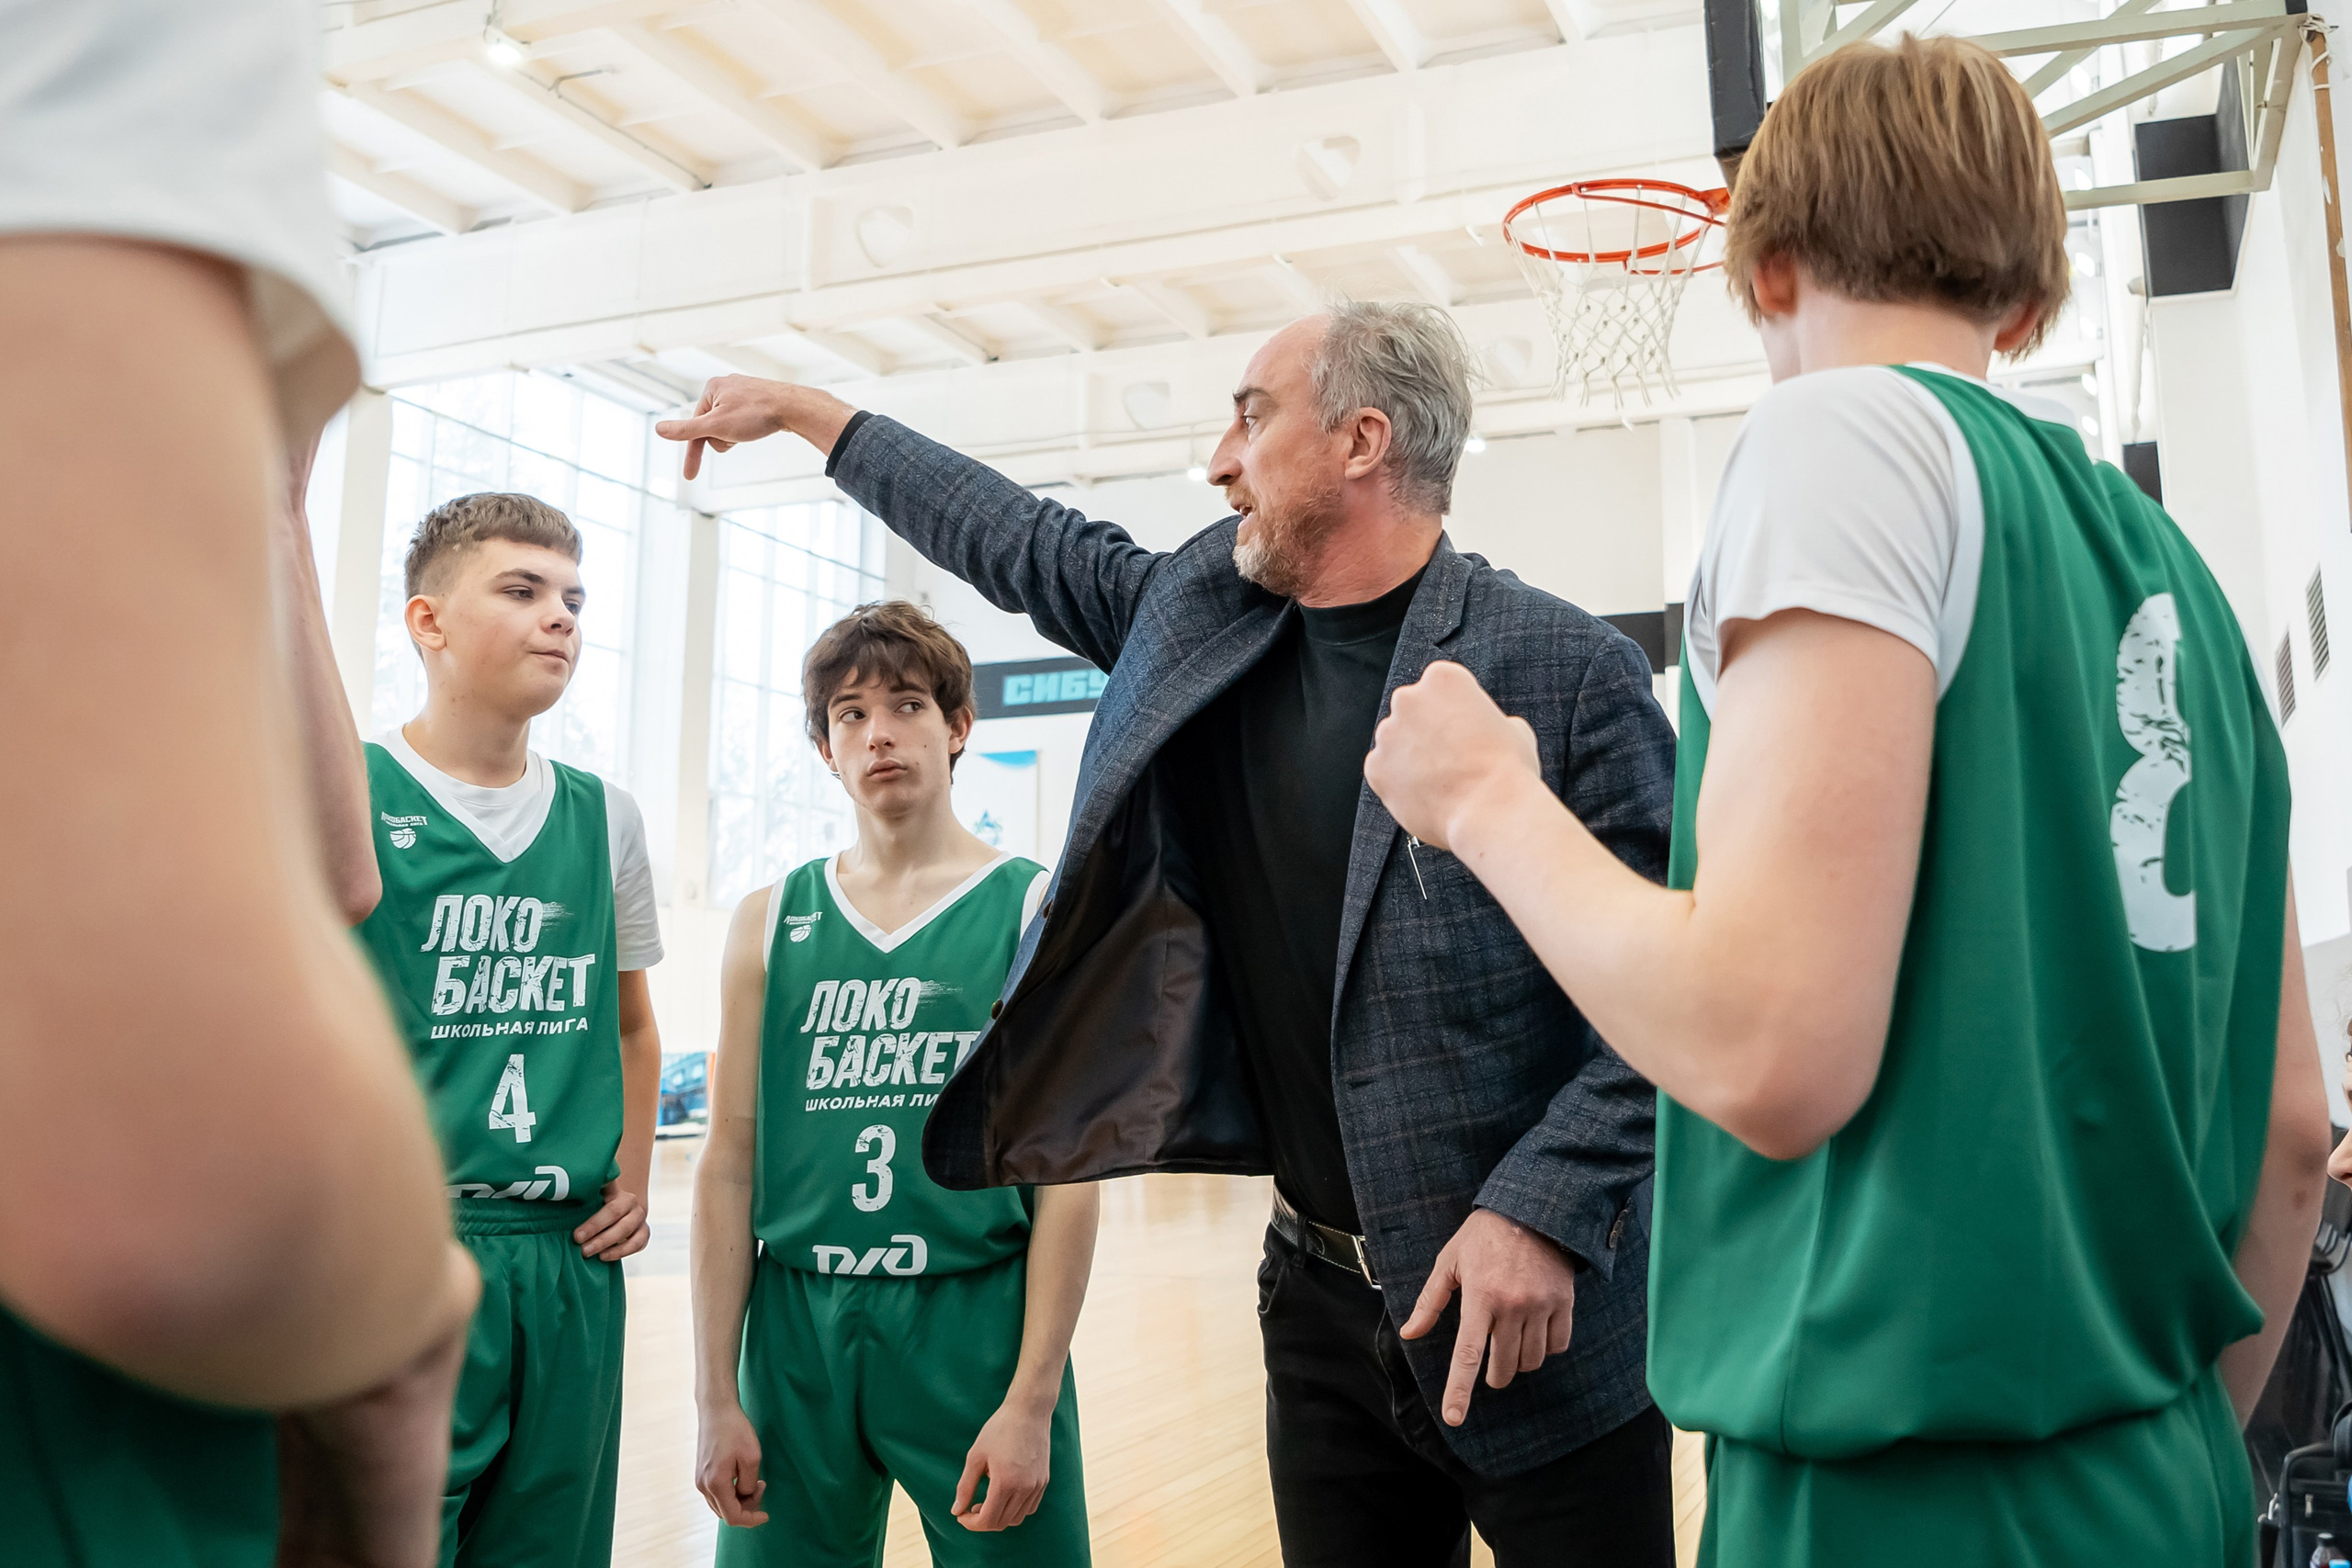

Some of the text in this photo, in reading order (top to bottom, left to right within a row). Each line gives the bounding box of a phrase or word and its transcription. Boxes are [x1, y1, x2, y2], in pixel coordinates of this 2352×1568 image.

[1002, 668, 1109, 706] СИБУ
[420, 894, 543, 953] ЛОКО
[431, 953, 596, 1016] БАСКЕТ
[800, 976, 922, 1033] ЛОКО
[430, 1017, 589, 1040] ШКОЛЬНАЯ ЛИГА
[805, 1030, 981, 1090] БАСКЕТ
[488, 1054, 537, 1144] 4
[805, 1093, 940, 1111] ШКОЛЬНАЯ ЛИ
[852, 1123, 896, 1213] 3
